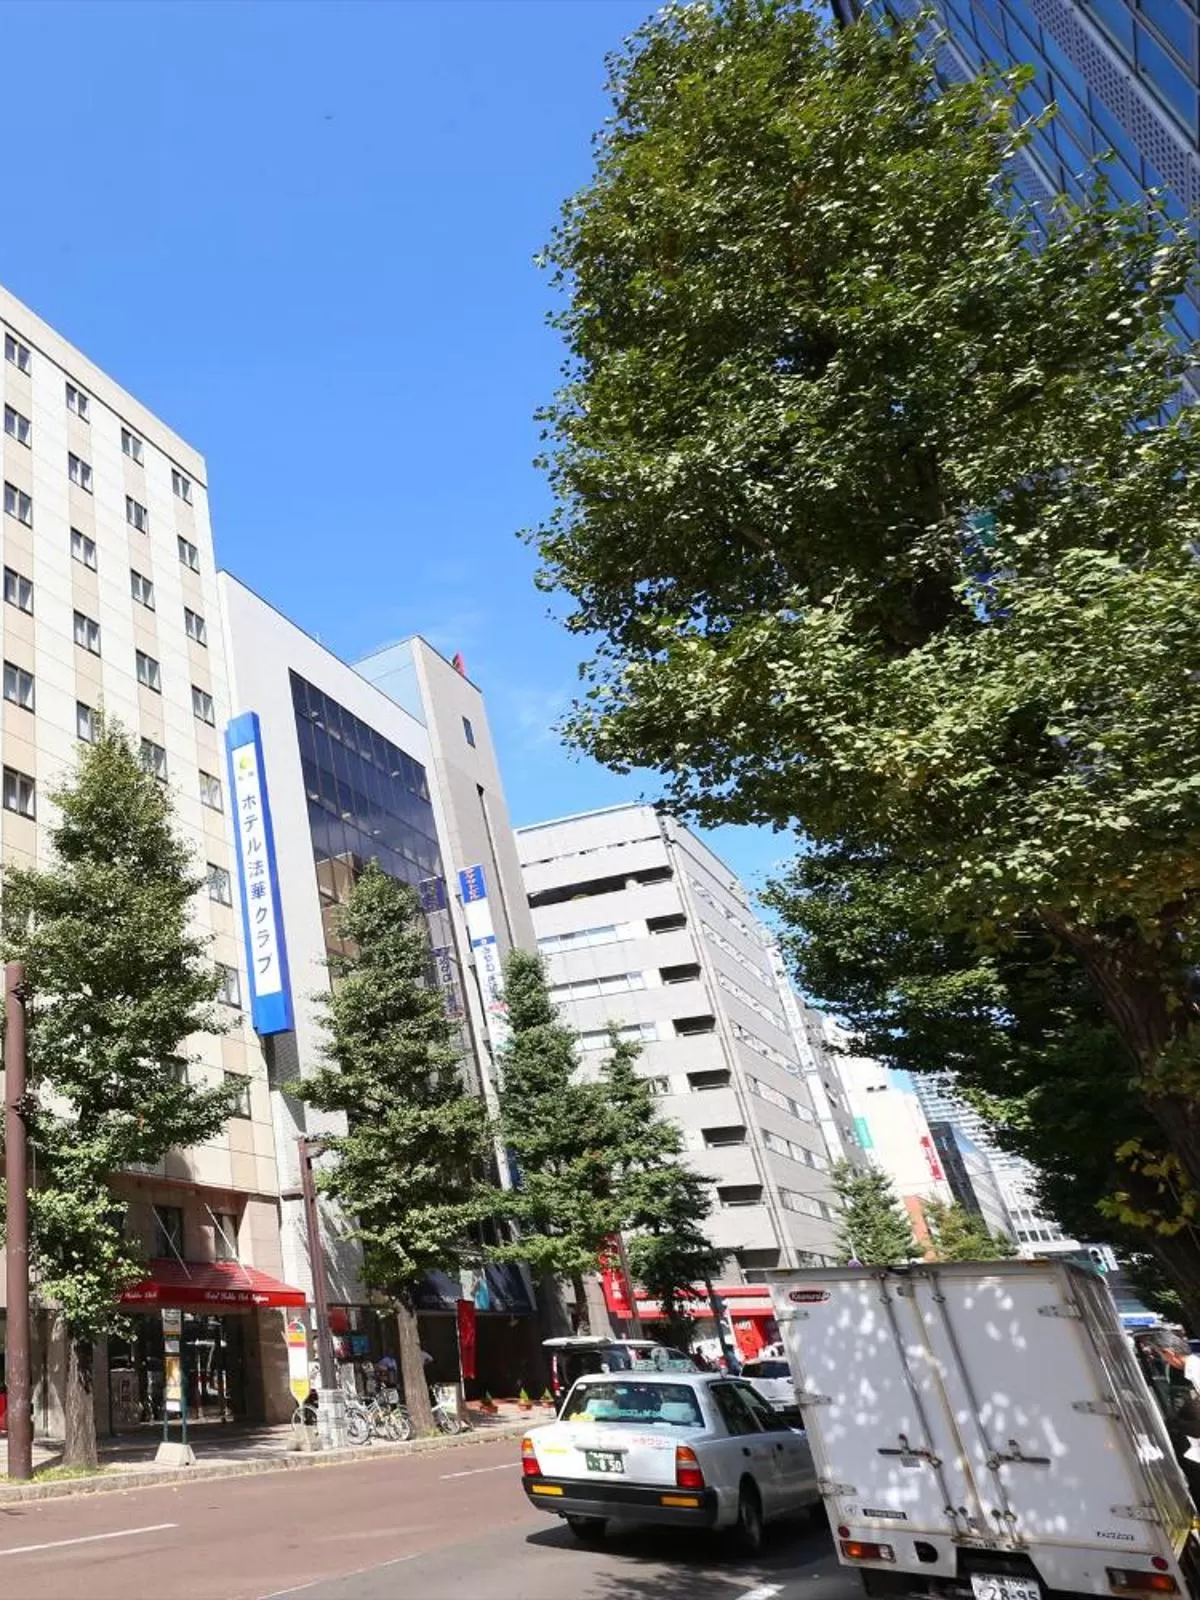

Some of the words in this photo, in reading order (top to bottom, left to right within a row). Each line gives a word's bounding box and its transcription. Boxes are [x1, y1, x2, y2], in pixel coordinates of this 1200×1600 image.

[241, 794, 273, 975] ホテル法華クラブ
